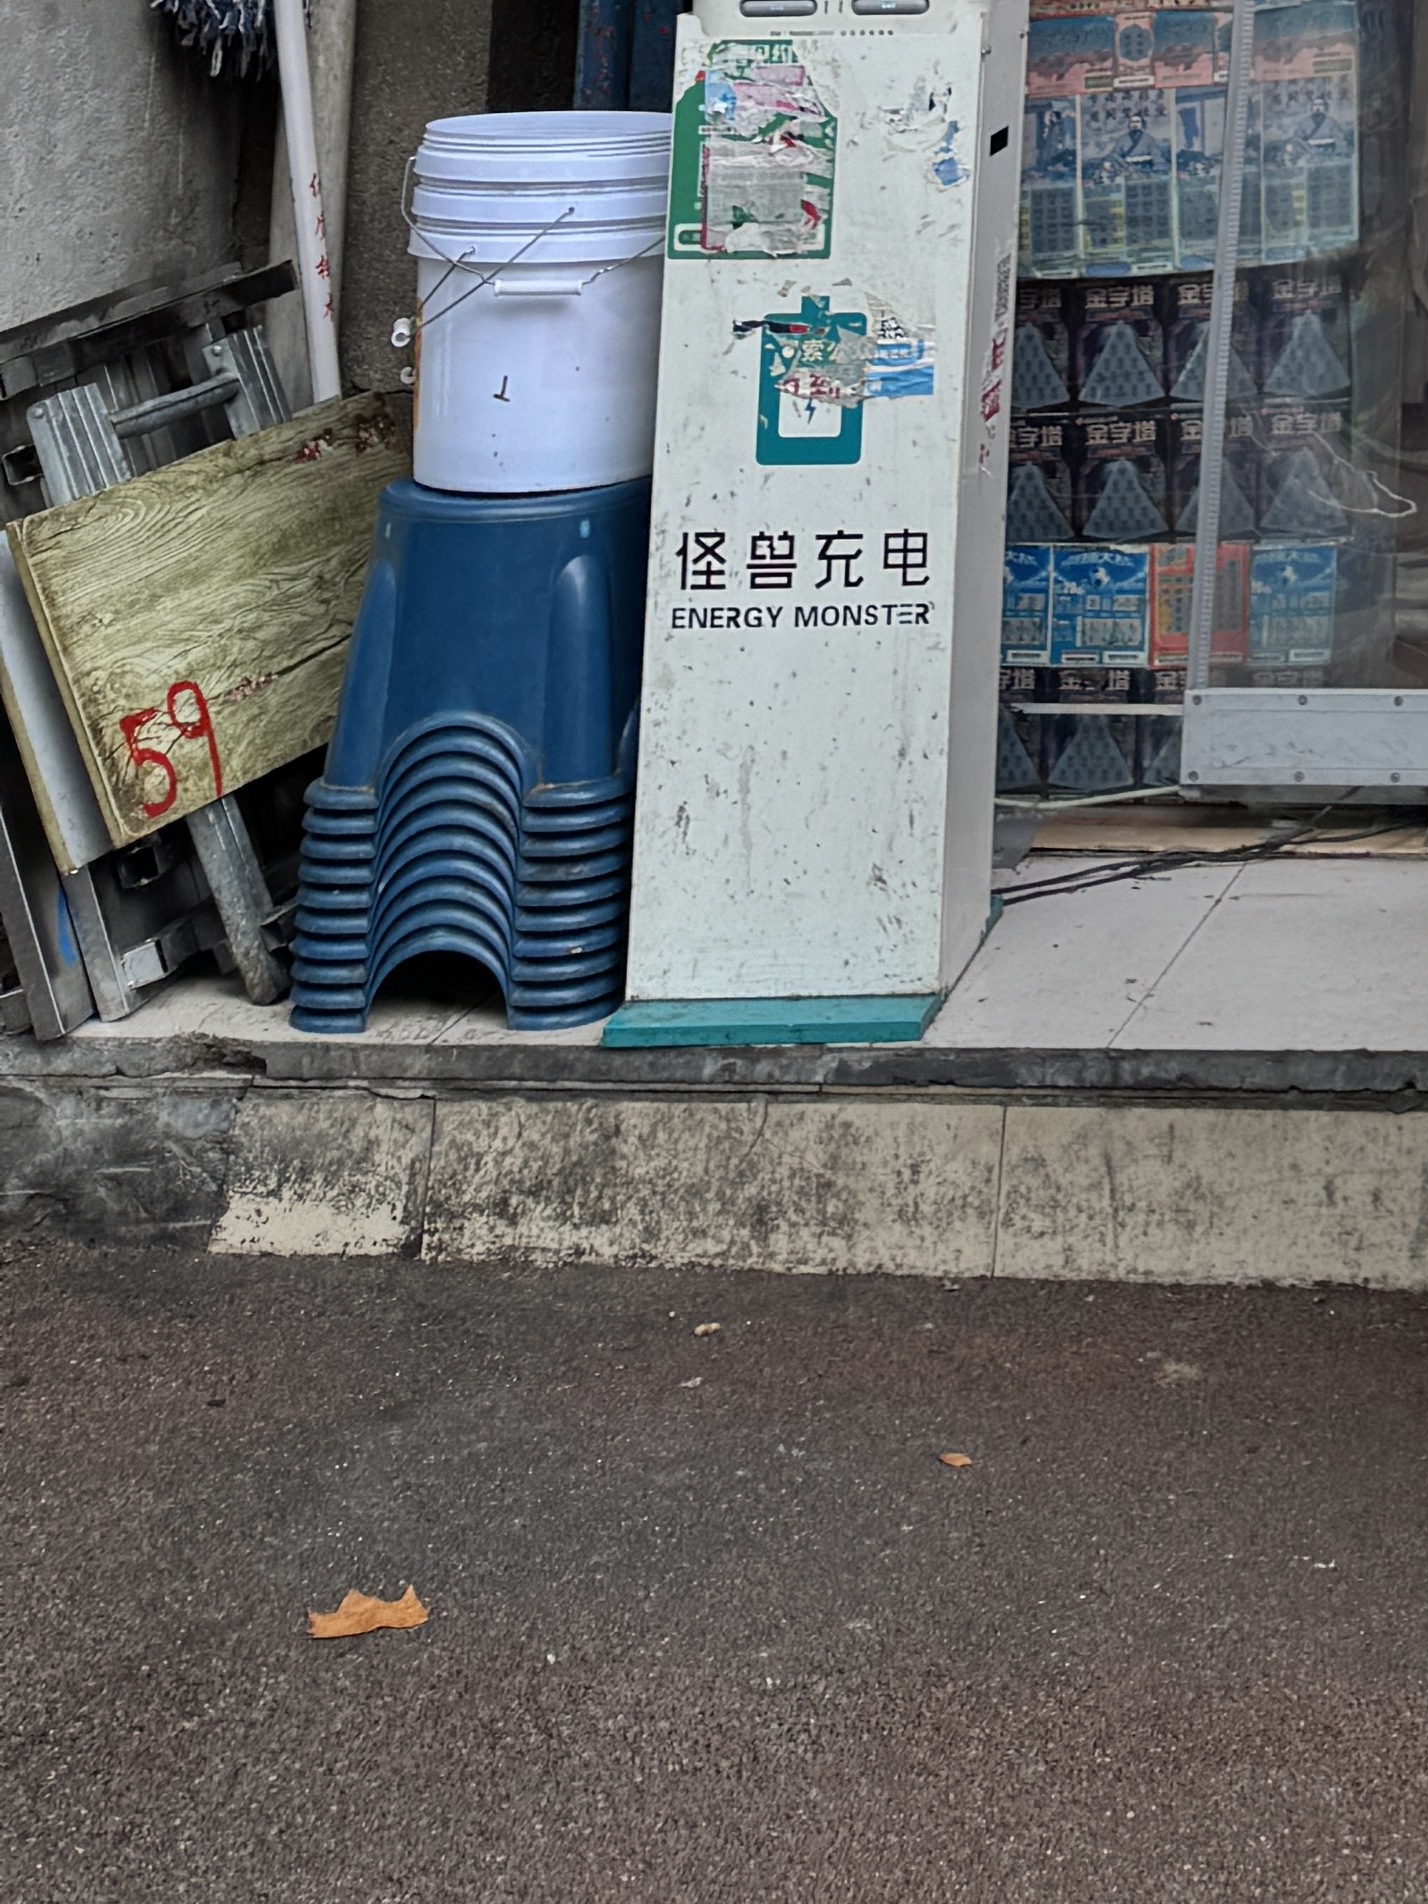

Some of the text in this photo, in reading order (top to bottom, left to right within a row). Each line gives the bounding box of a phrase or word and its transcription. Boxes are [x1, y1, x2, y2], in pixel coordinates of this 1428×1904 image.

[675, 528, 931, 592] 怪兽充电
[671, 602, 932, 630] ENERGY MONSTER
[119, 679, 225, 820] 59
